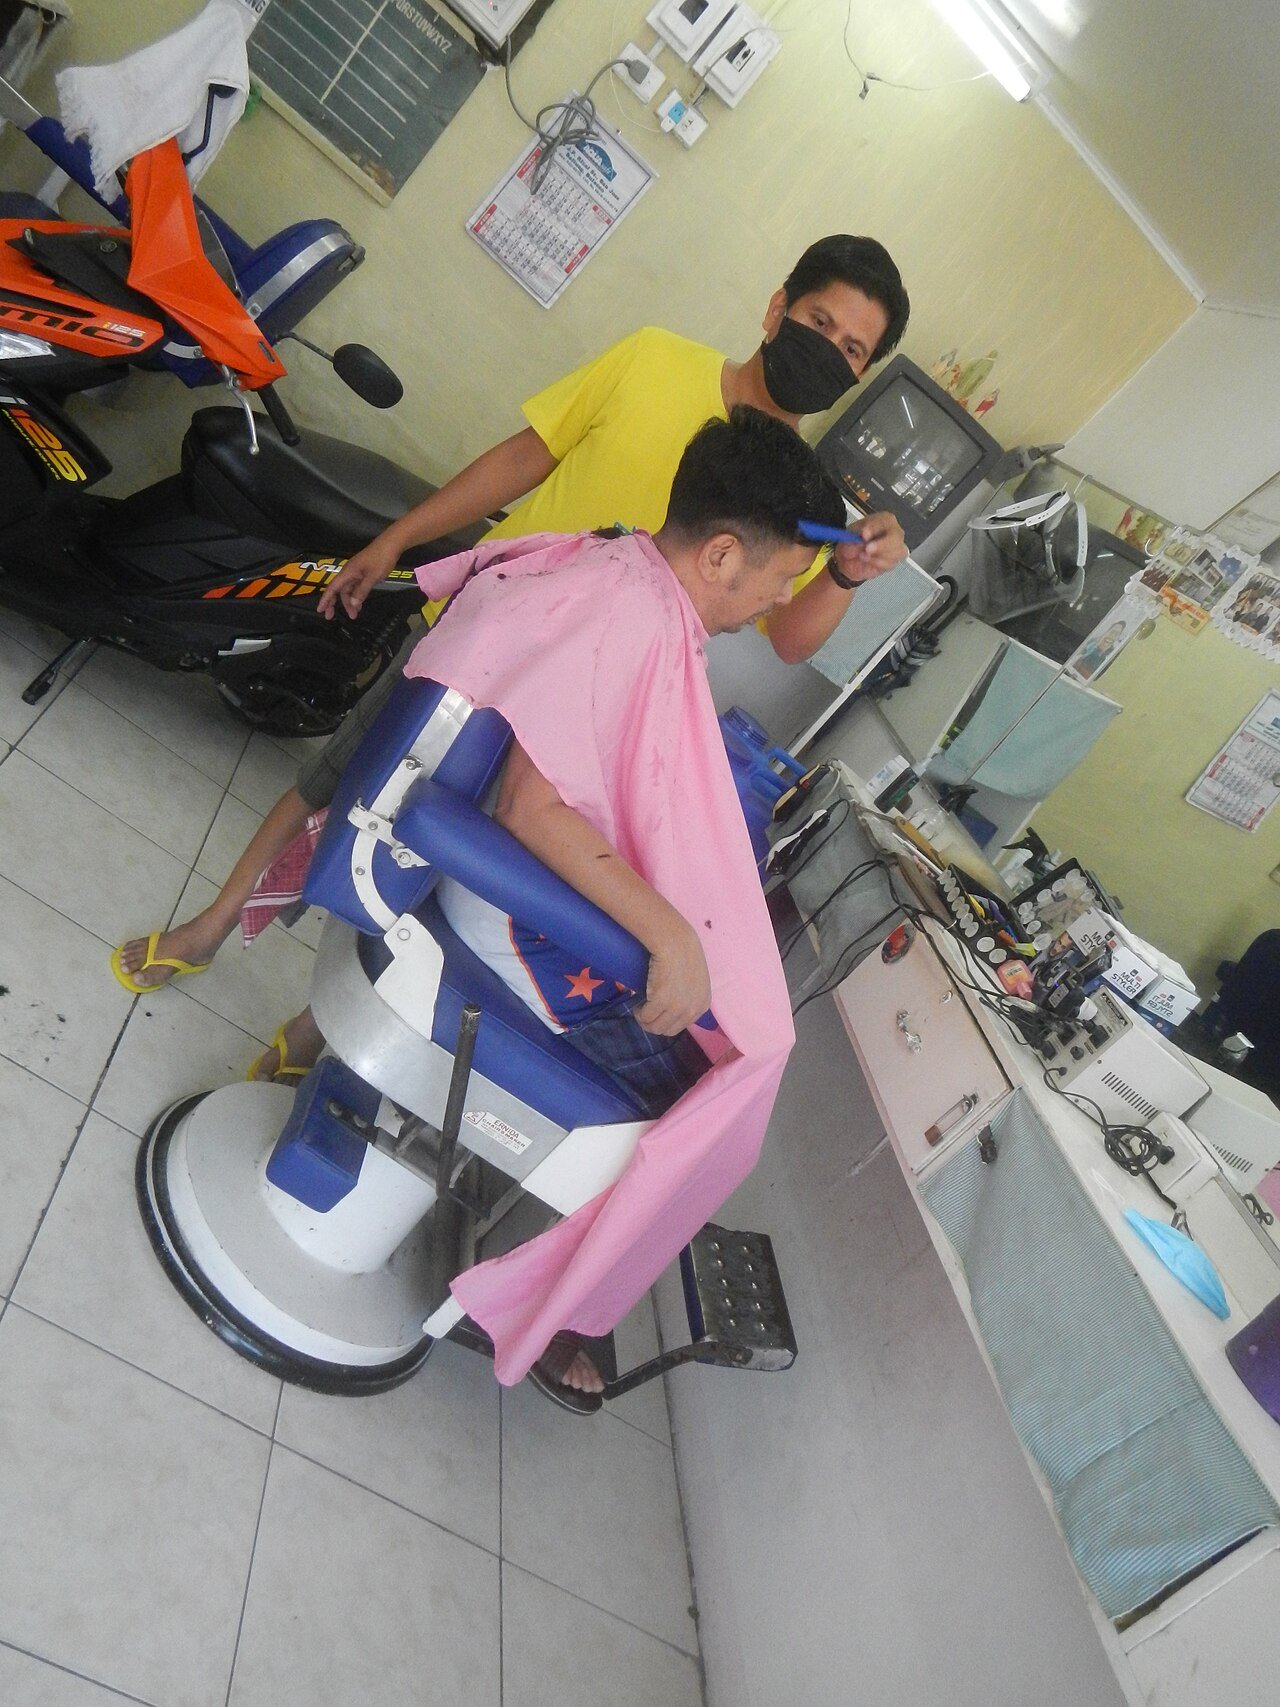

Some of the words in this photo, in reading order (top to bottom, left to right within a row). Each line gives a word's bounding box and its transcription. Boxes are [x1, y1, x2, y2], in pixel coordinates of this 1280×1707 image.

[389, 0, 453, 55] QRSTUVWXYZ
[1111, 973, 1137, 995] STYLER
[1120, 971, 1141, 989] MULTI
[493, 1119, 520, 1139] ERNIDA
